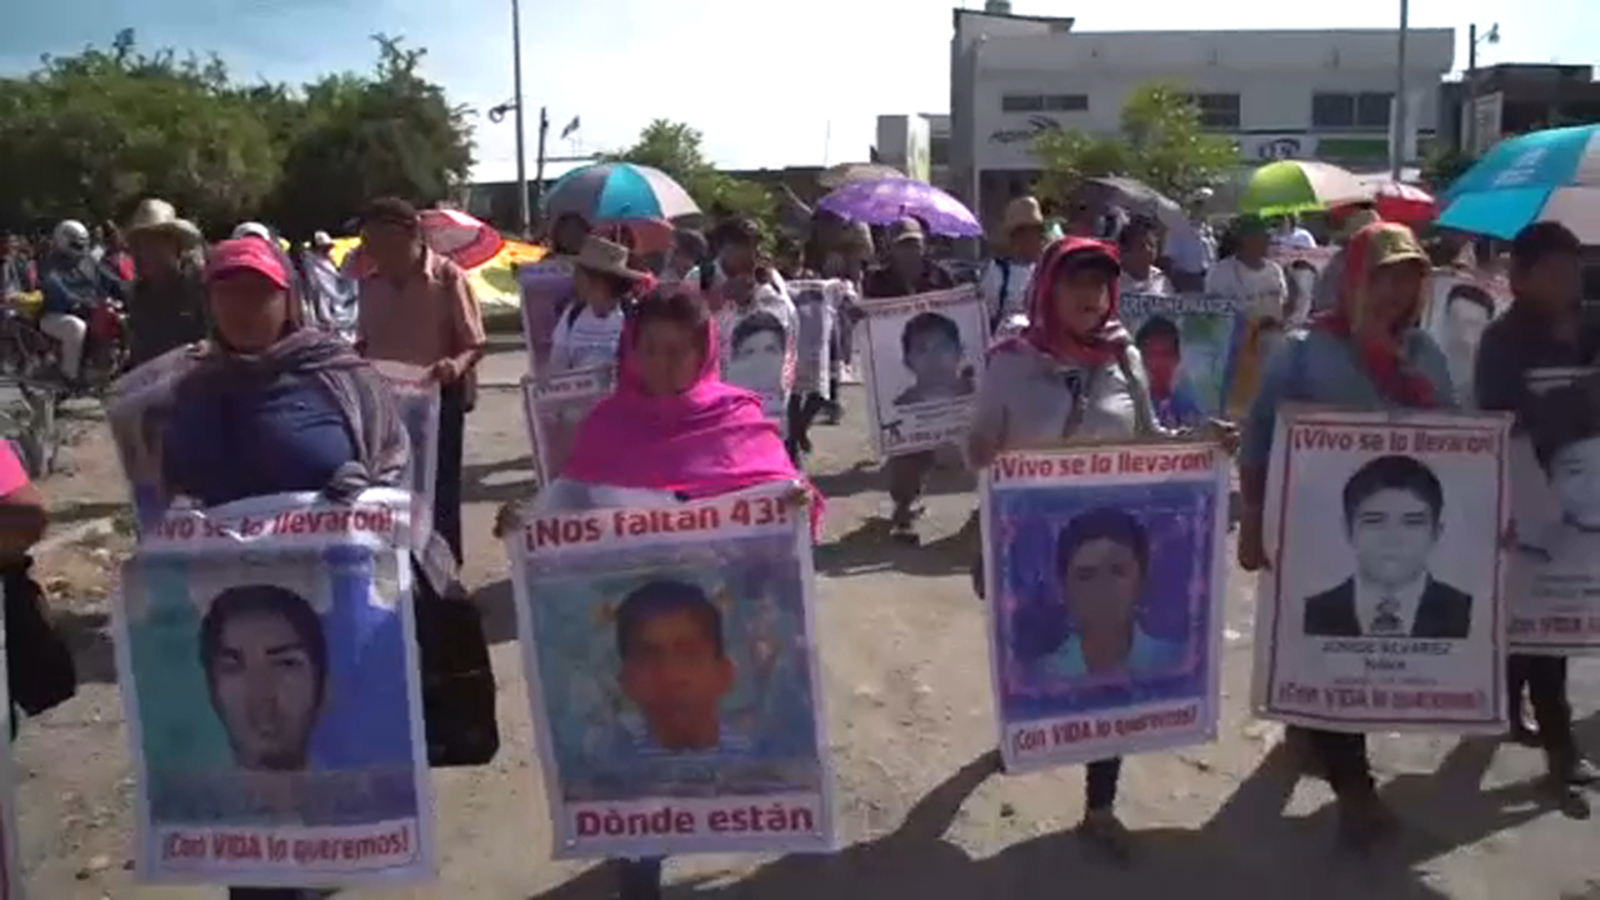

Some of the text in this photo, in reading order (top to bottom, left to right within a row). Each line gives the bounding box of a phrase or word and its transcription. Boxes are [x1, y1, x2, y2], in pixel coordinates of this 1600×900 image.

[1359, 430, 1384, 450] se
[1389, 429, 1408, 451] lo
[1058, 458, 1086, 477] se
[1091, 453, 1112, 474] lo
[1118, 449, 1215, 475] llevaron!
[271, 506, 393, 535] llevaron!
[524, 496, 788, 551] ¡Nos faltan 43!
[1052, 720, 1090, 746] VIDA
[1095, 719, 1112, 739] lo
[212, 831, 263, 860] VIDA
[266, 834, 288, 862] lo
[292, 827, 409, 864] queremos!
